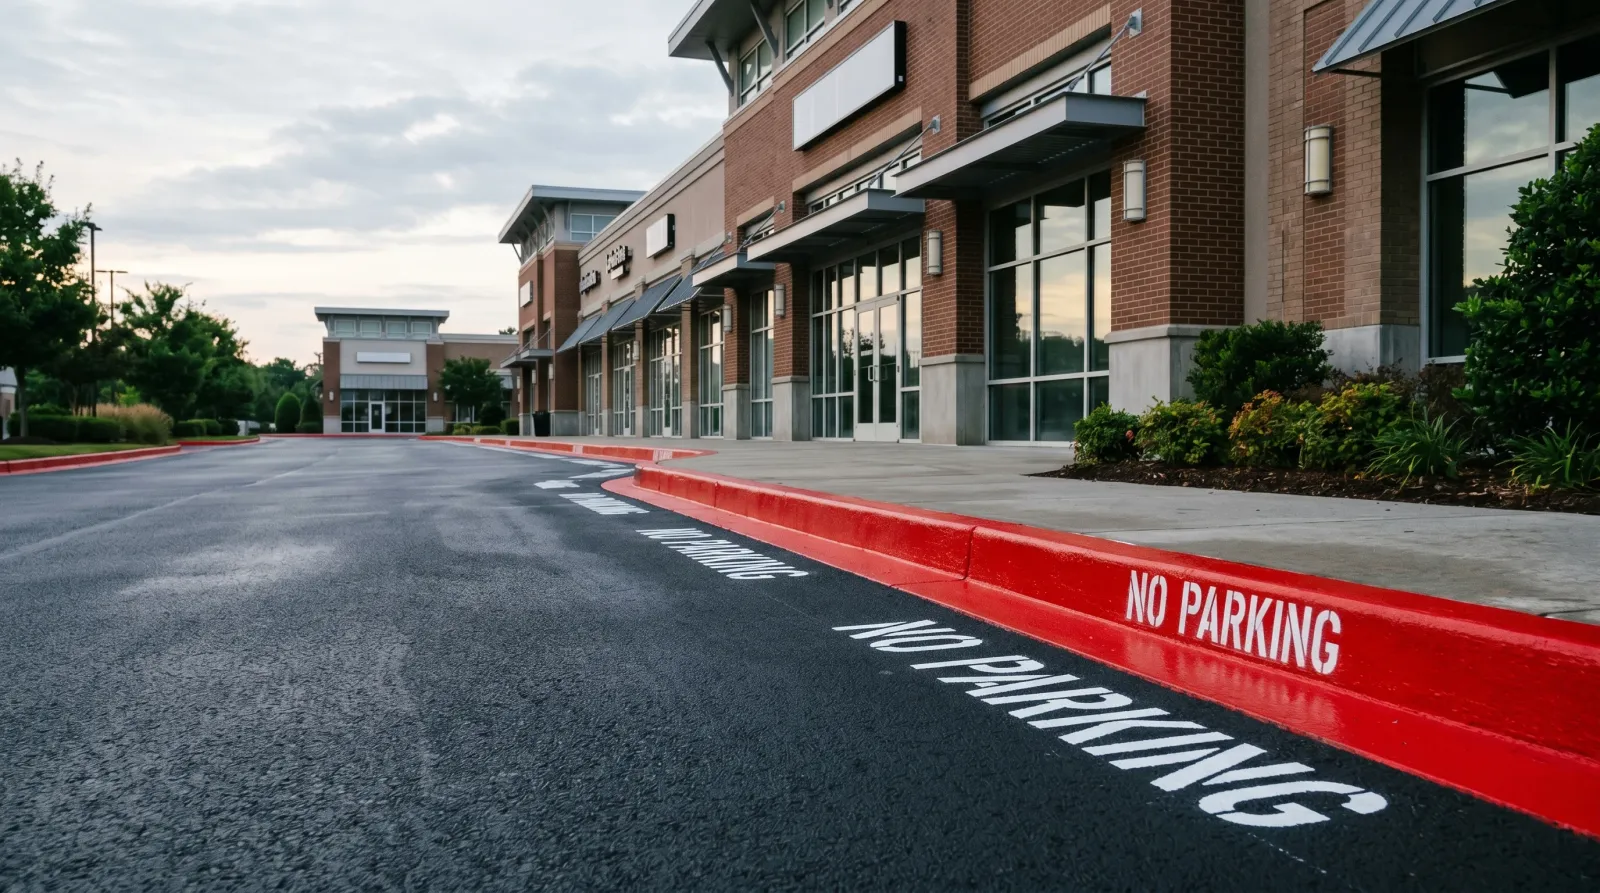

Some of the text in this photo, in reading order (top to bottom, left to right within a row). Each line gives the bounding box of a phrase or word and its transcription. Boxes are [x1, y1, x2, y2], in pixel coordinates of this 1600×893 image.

[635, 527, 809, 580] NO PARKING
[1126, 570, 1341, 675] NO PARKING
[832, 619, 1388, 828] NO PARKING
